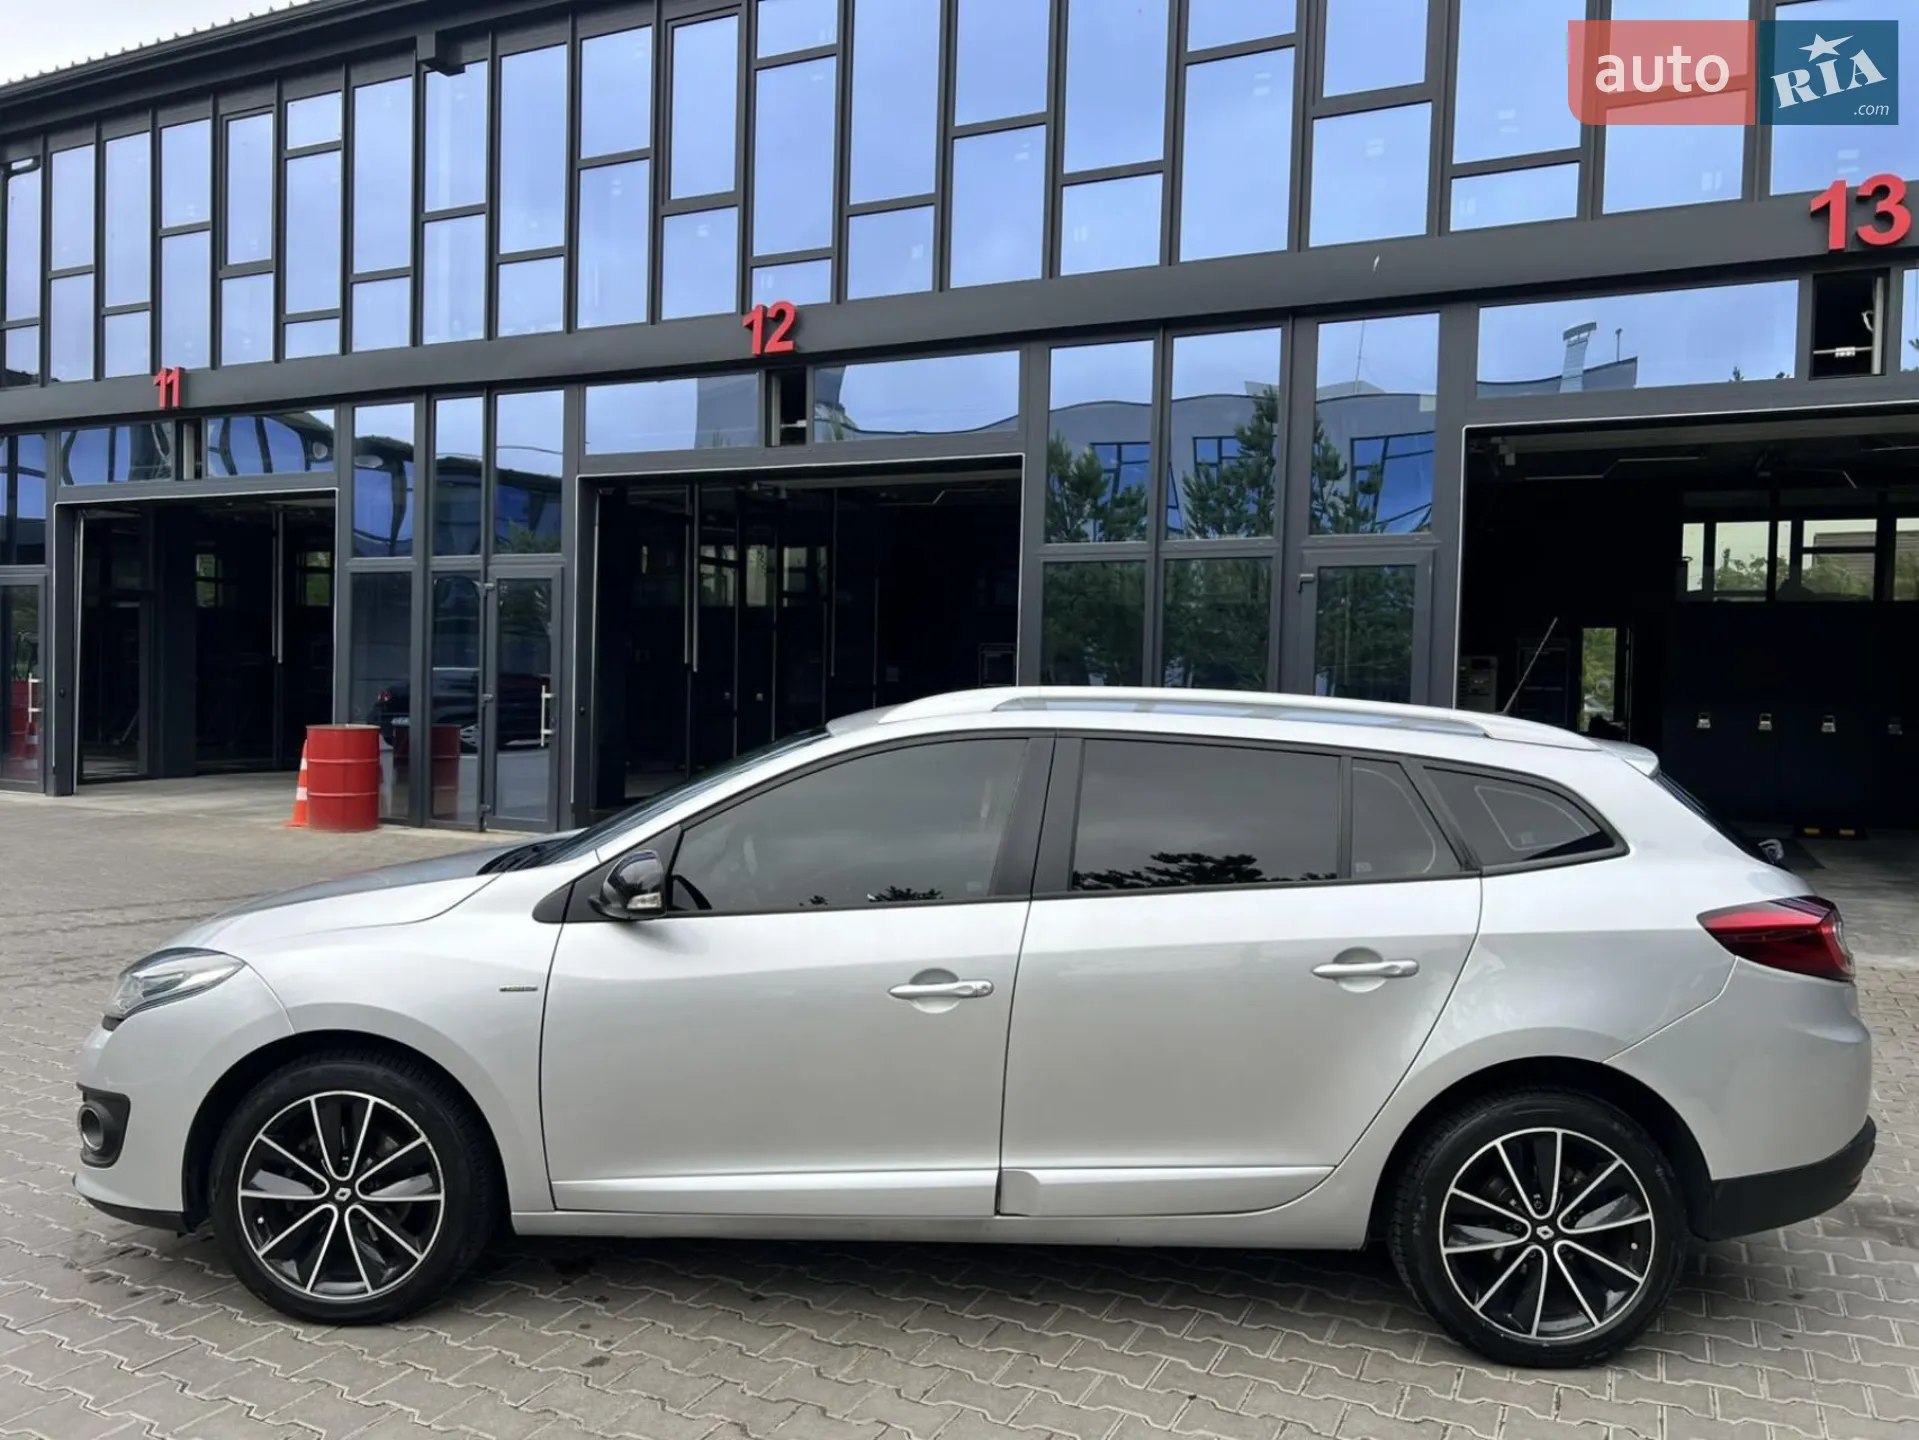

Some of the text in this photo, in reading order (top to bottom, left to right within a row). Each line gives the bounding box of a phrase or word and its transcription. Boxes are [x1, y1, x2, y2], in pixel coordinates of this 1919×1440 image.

[1808, 172, 1912, 252] 13
[742, 300, 796, 356] 12
[152, 366, 182, 410] 11
